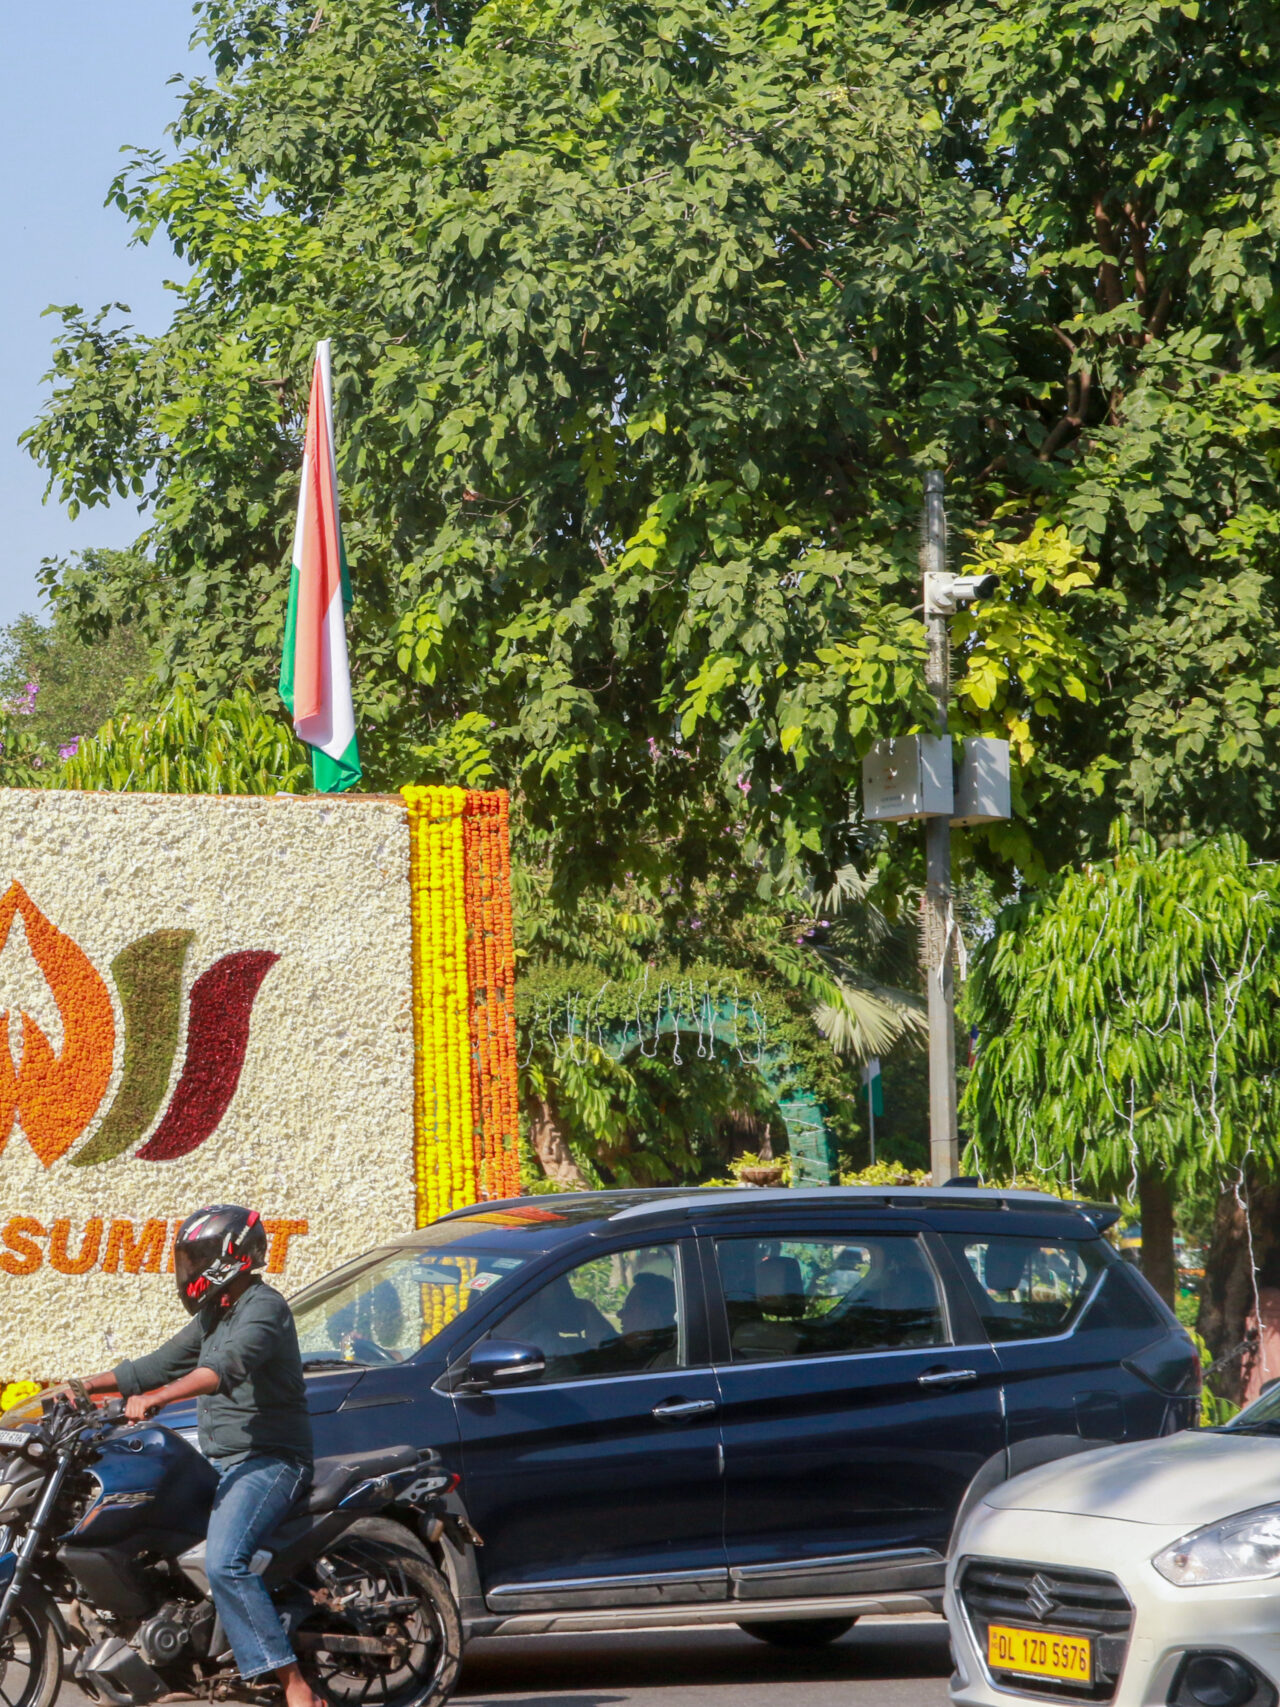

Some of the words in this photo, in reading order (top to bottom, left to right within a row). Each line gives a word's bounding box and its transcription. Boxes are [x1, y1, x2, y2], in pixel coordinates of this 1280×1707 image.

[999, 1635, 1016, 1661] DL
[1023, 1638, 1047, 1665] 1ZD
[1052, 1642, 1087, 1672] 5976
